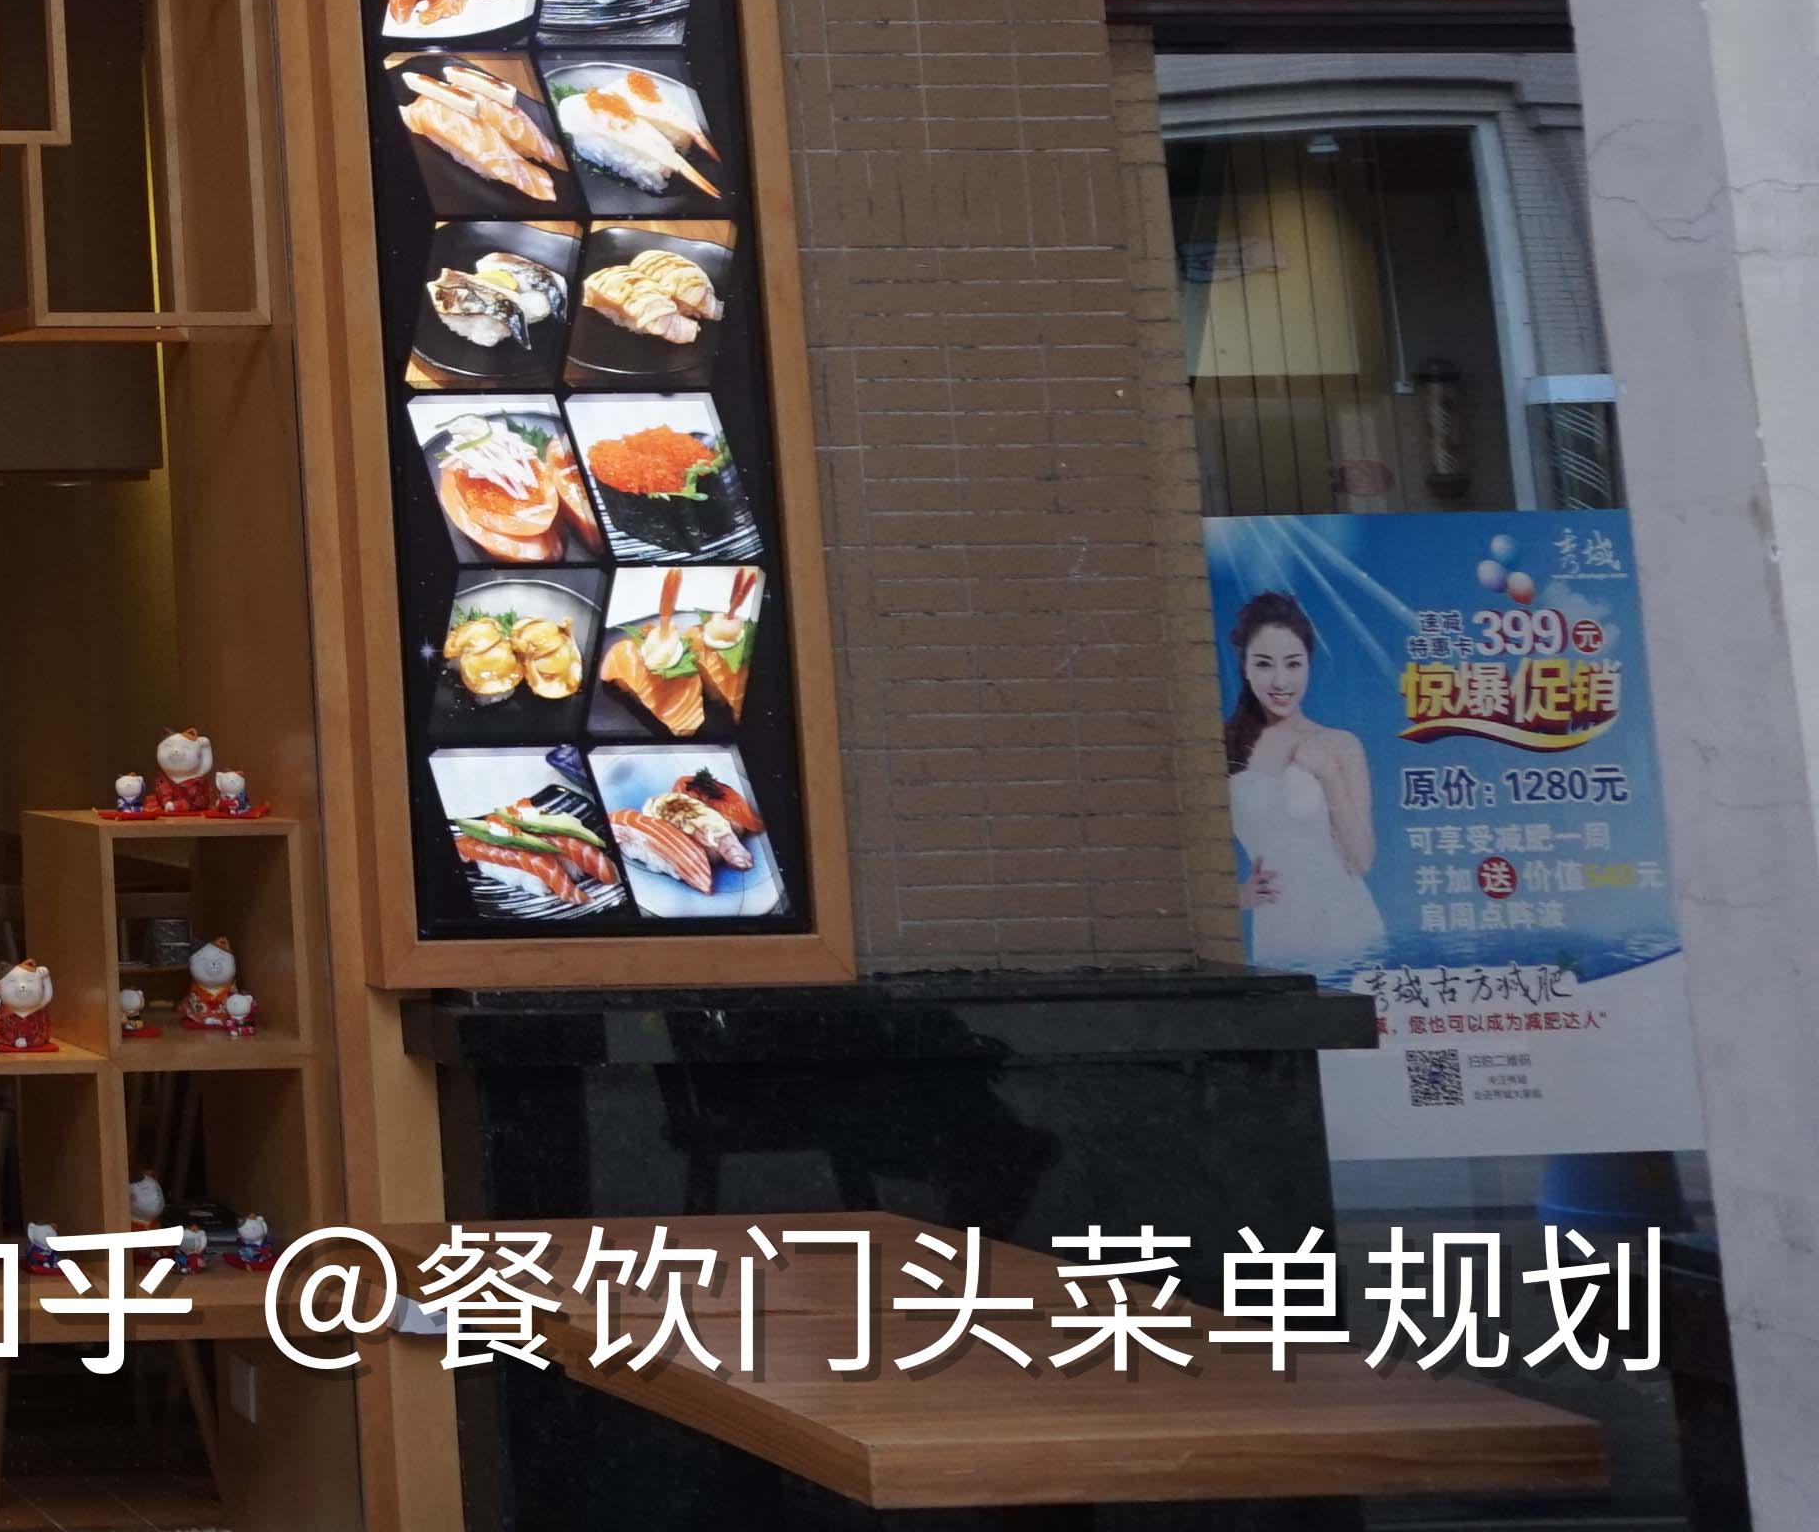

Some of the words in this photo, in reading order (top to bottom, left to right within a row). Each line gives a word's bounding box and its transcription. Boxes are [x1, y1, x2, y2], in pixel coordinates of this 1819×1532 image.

[1400, 658, 1622, 725] 惊爆促销
[1406, 822, 1611, 856] 可享受减肥一周
